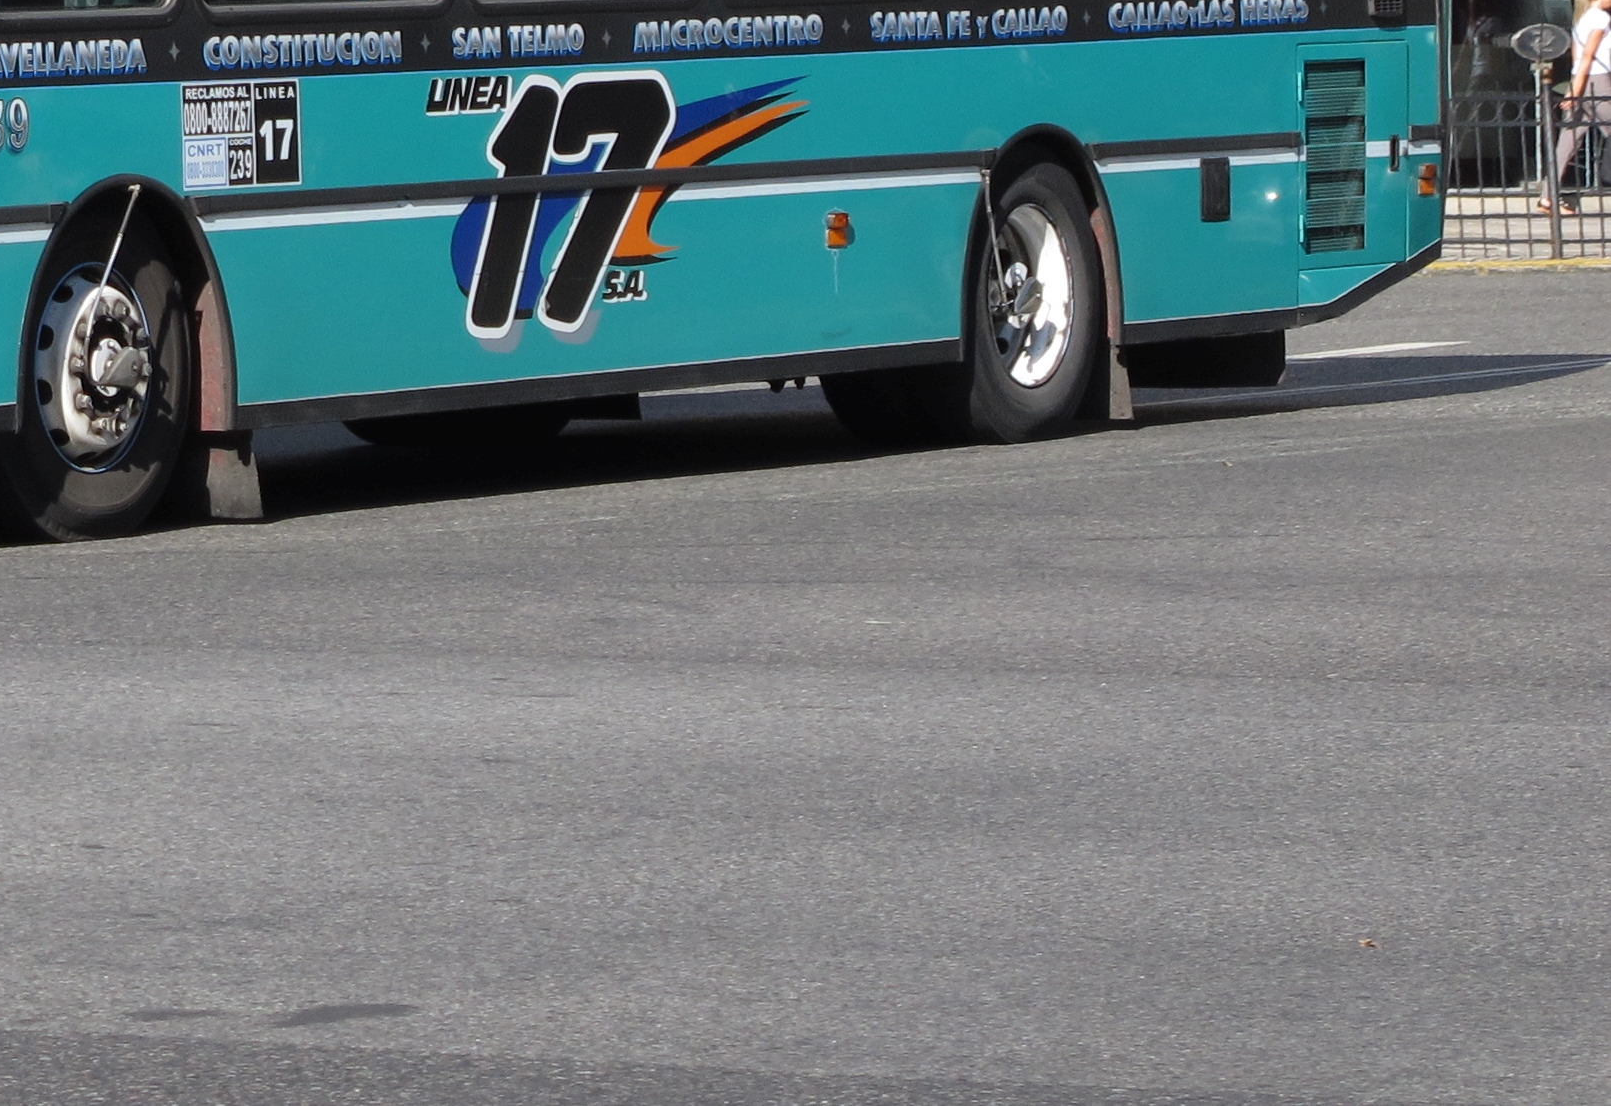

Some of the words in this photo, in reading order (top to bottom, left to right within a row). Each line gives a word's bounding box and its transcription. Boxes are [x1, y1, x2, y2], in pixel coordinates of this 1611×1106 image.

[633, 14, 824, 53] MICROCENTRO
[870, 11, 943, 42] SANTA
[946, 11, 972, 40] FE
[991, 6, 1068, 37] CALLAO
[1108, 2, 1189, 33] CALLAO
[202, 30, 402, 71] CONSTITUCION
[452, 27, 502, 59] SAN
[505, 23, 584, 56] TELMO
[185, 87, 235, 100] RECLAMOS
[236, 86, 249, 98] AL
[255, 86, 295, 100] LINEA
[426, 76, 512, 116] LINEA
[184, 100, 252, 134] 0800-8887267
[188, 143, 223, 157] CNRT
[259, 119, 294, 161] 17
[229, 149, 253, 180] 239
[466, 69, 676, 340] 17
